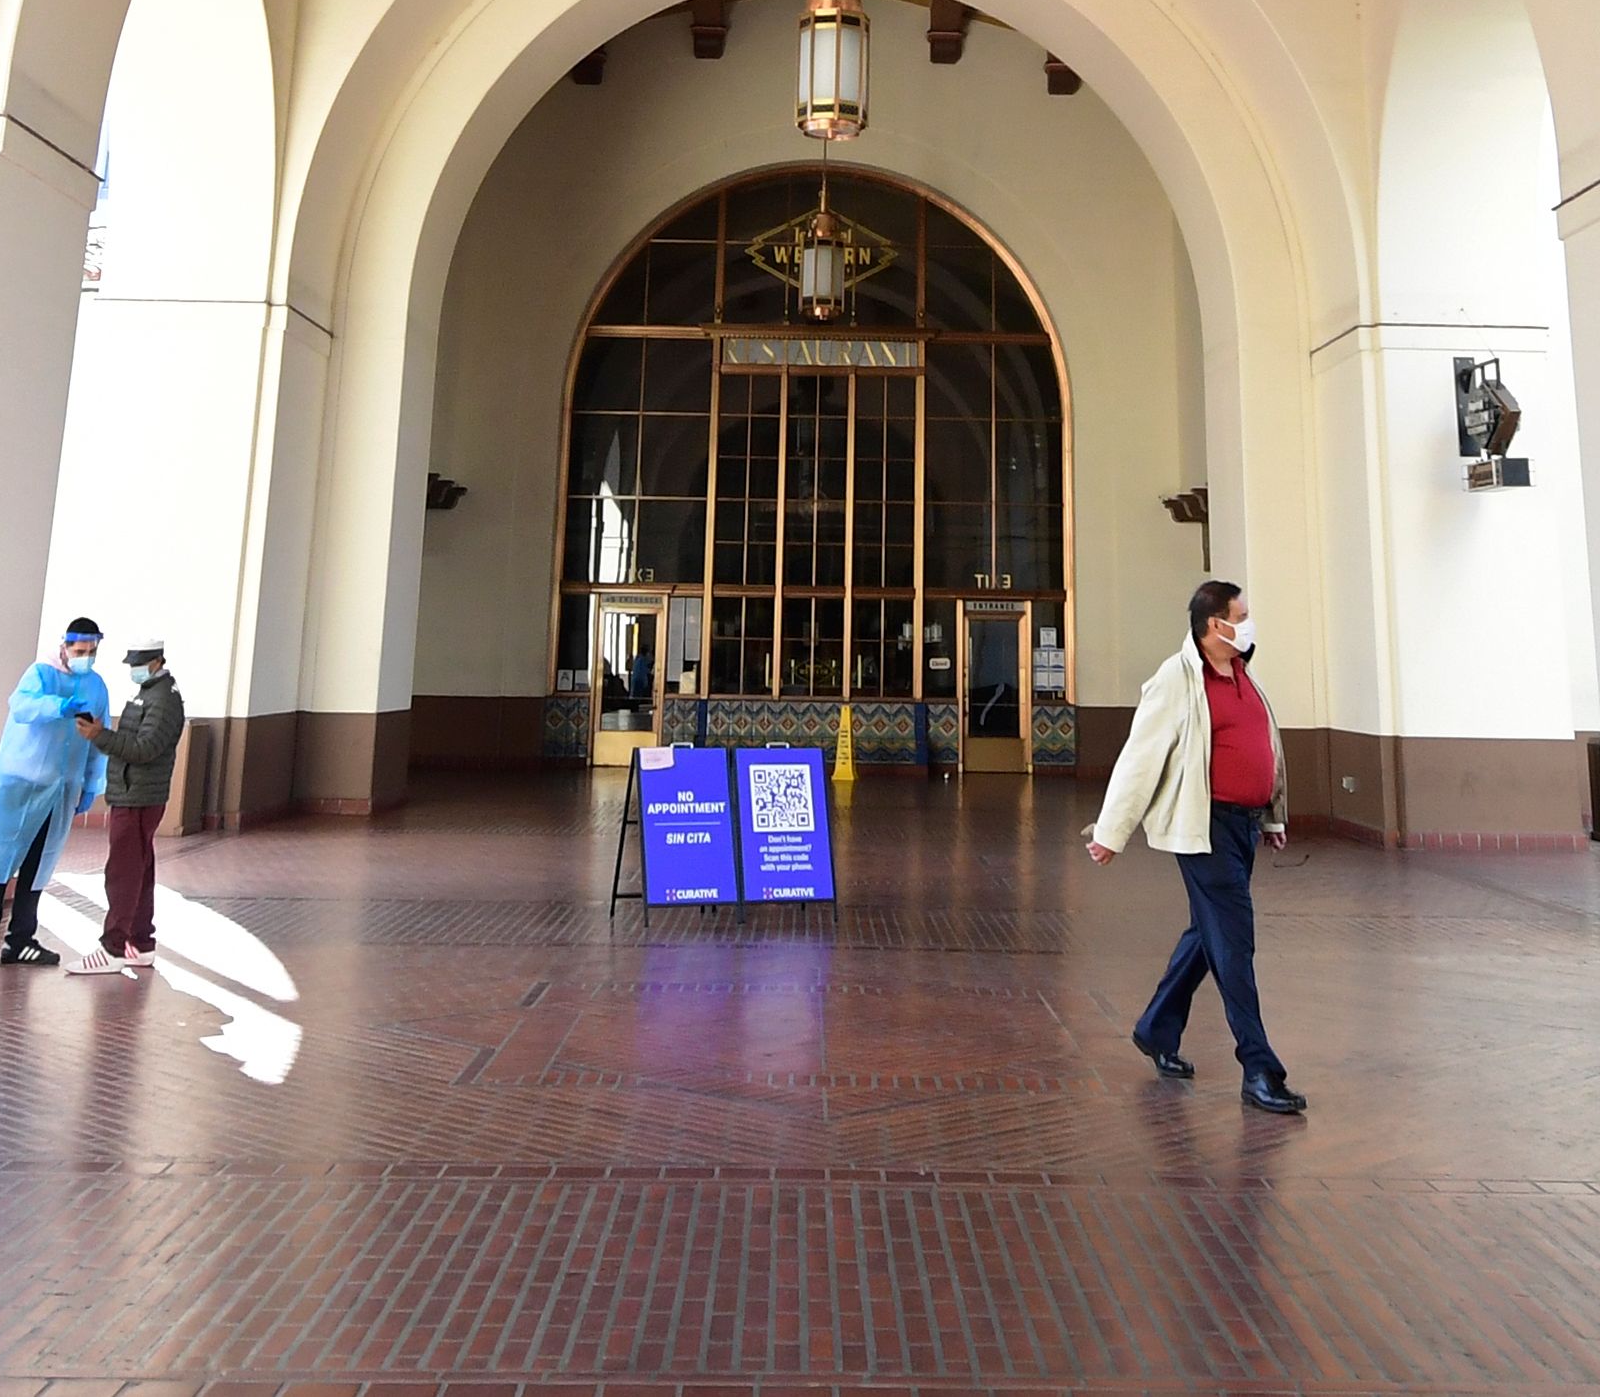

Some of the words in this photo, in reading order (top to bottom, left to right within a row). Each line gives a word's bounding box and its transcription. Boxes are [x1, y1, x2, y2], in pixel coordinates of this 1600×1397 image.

[773, 246, 871, 265] WERN
[677, 791, 694, 802] NO
[647, 802, 726, 815] APPOINTMENT
[666, 832, 685, 845] SIN
[687, 832, 711, 844] CITA
[676, 888, 719, 900] CURATIVE
[773, 887, 815, 898] CURATIVE
